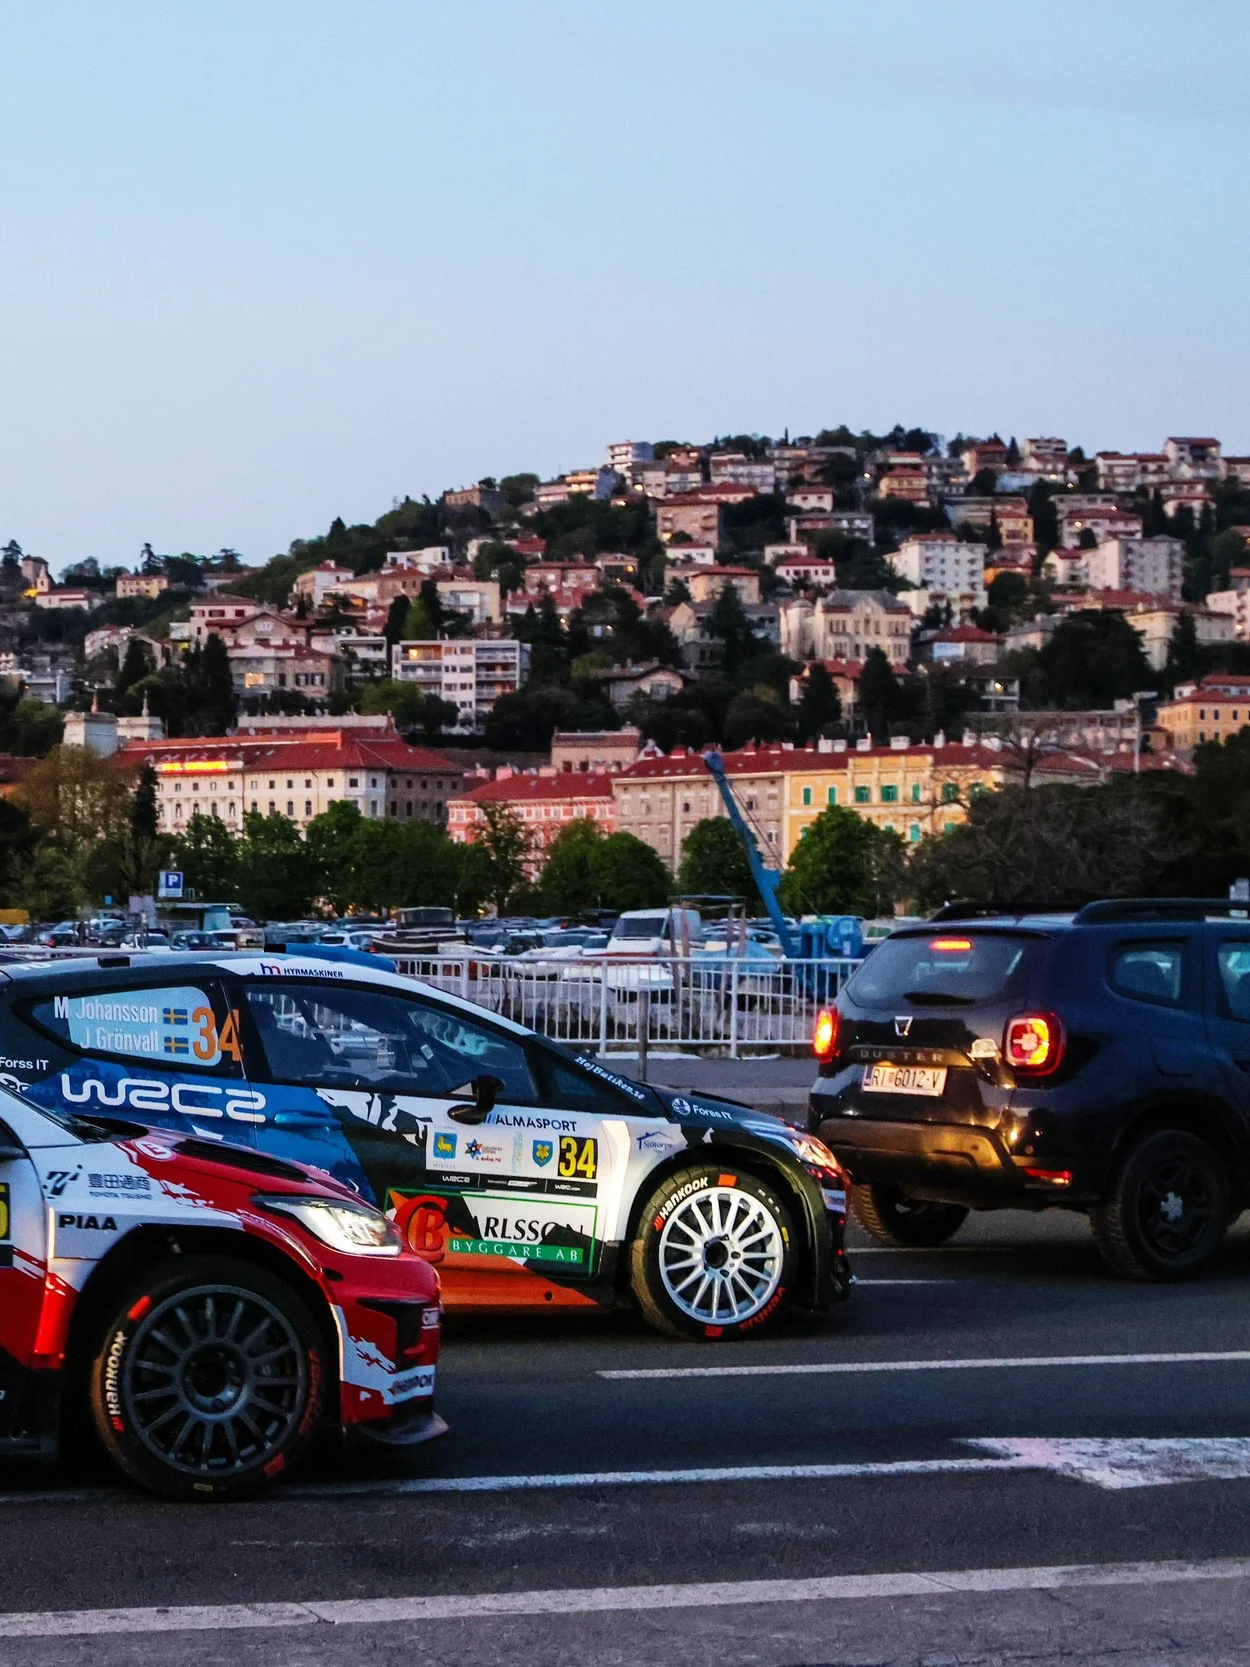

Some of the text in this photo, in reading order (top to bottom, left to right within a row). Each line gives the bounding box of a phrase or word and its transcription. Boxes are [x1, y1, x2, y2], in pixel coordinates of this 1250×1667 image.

[168, 874, 179, 886] P
[283, 967, 344, 978] HYRMASKINER
[54, 996, 158, 1024] M Johansson
[80, 1026, 159, 1052] J Grönvall
[191, 1006, 243, 1063] 34
[36, 1059, 49, 1071] IT
[860, 1049, 943, 1062] DUSTER
[61, 1073, 266, 1123] WRC2
[495, 1114, 577, 1132] ALMASPORT
[559, 1137, 596, 1179] 34
[58, 1214, 118, 1231] PIAA
[452, 1241, 579, 1262] BYGGARE AB
